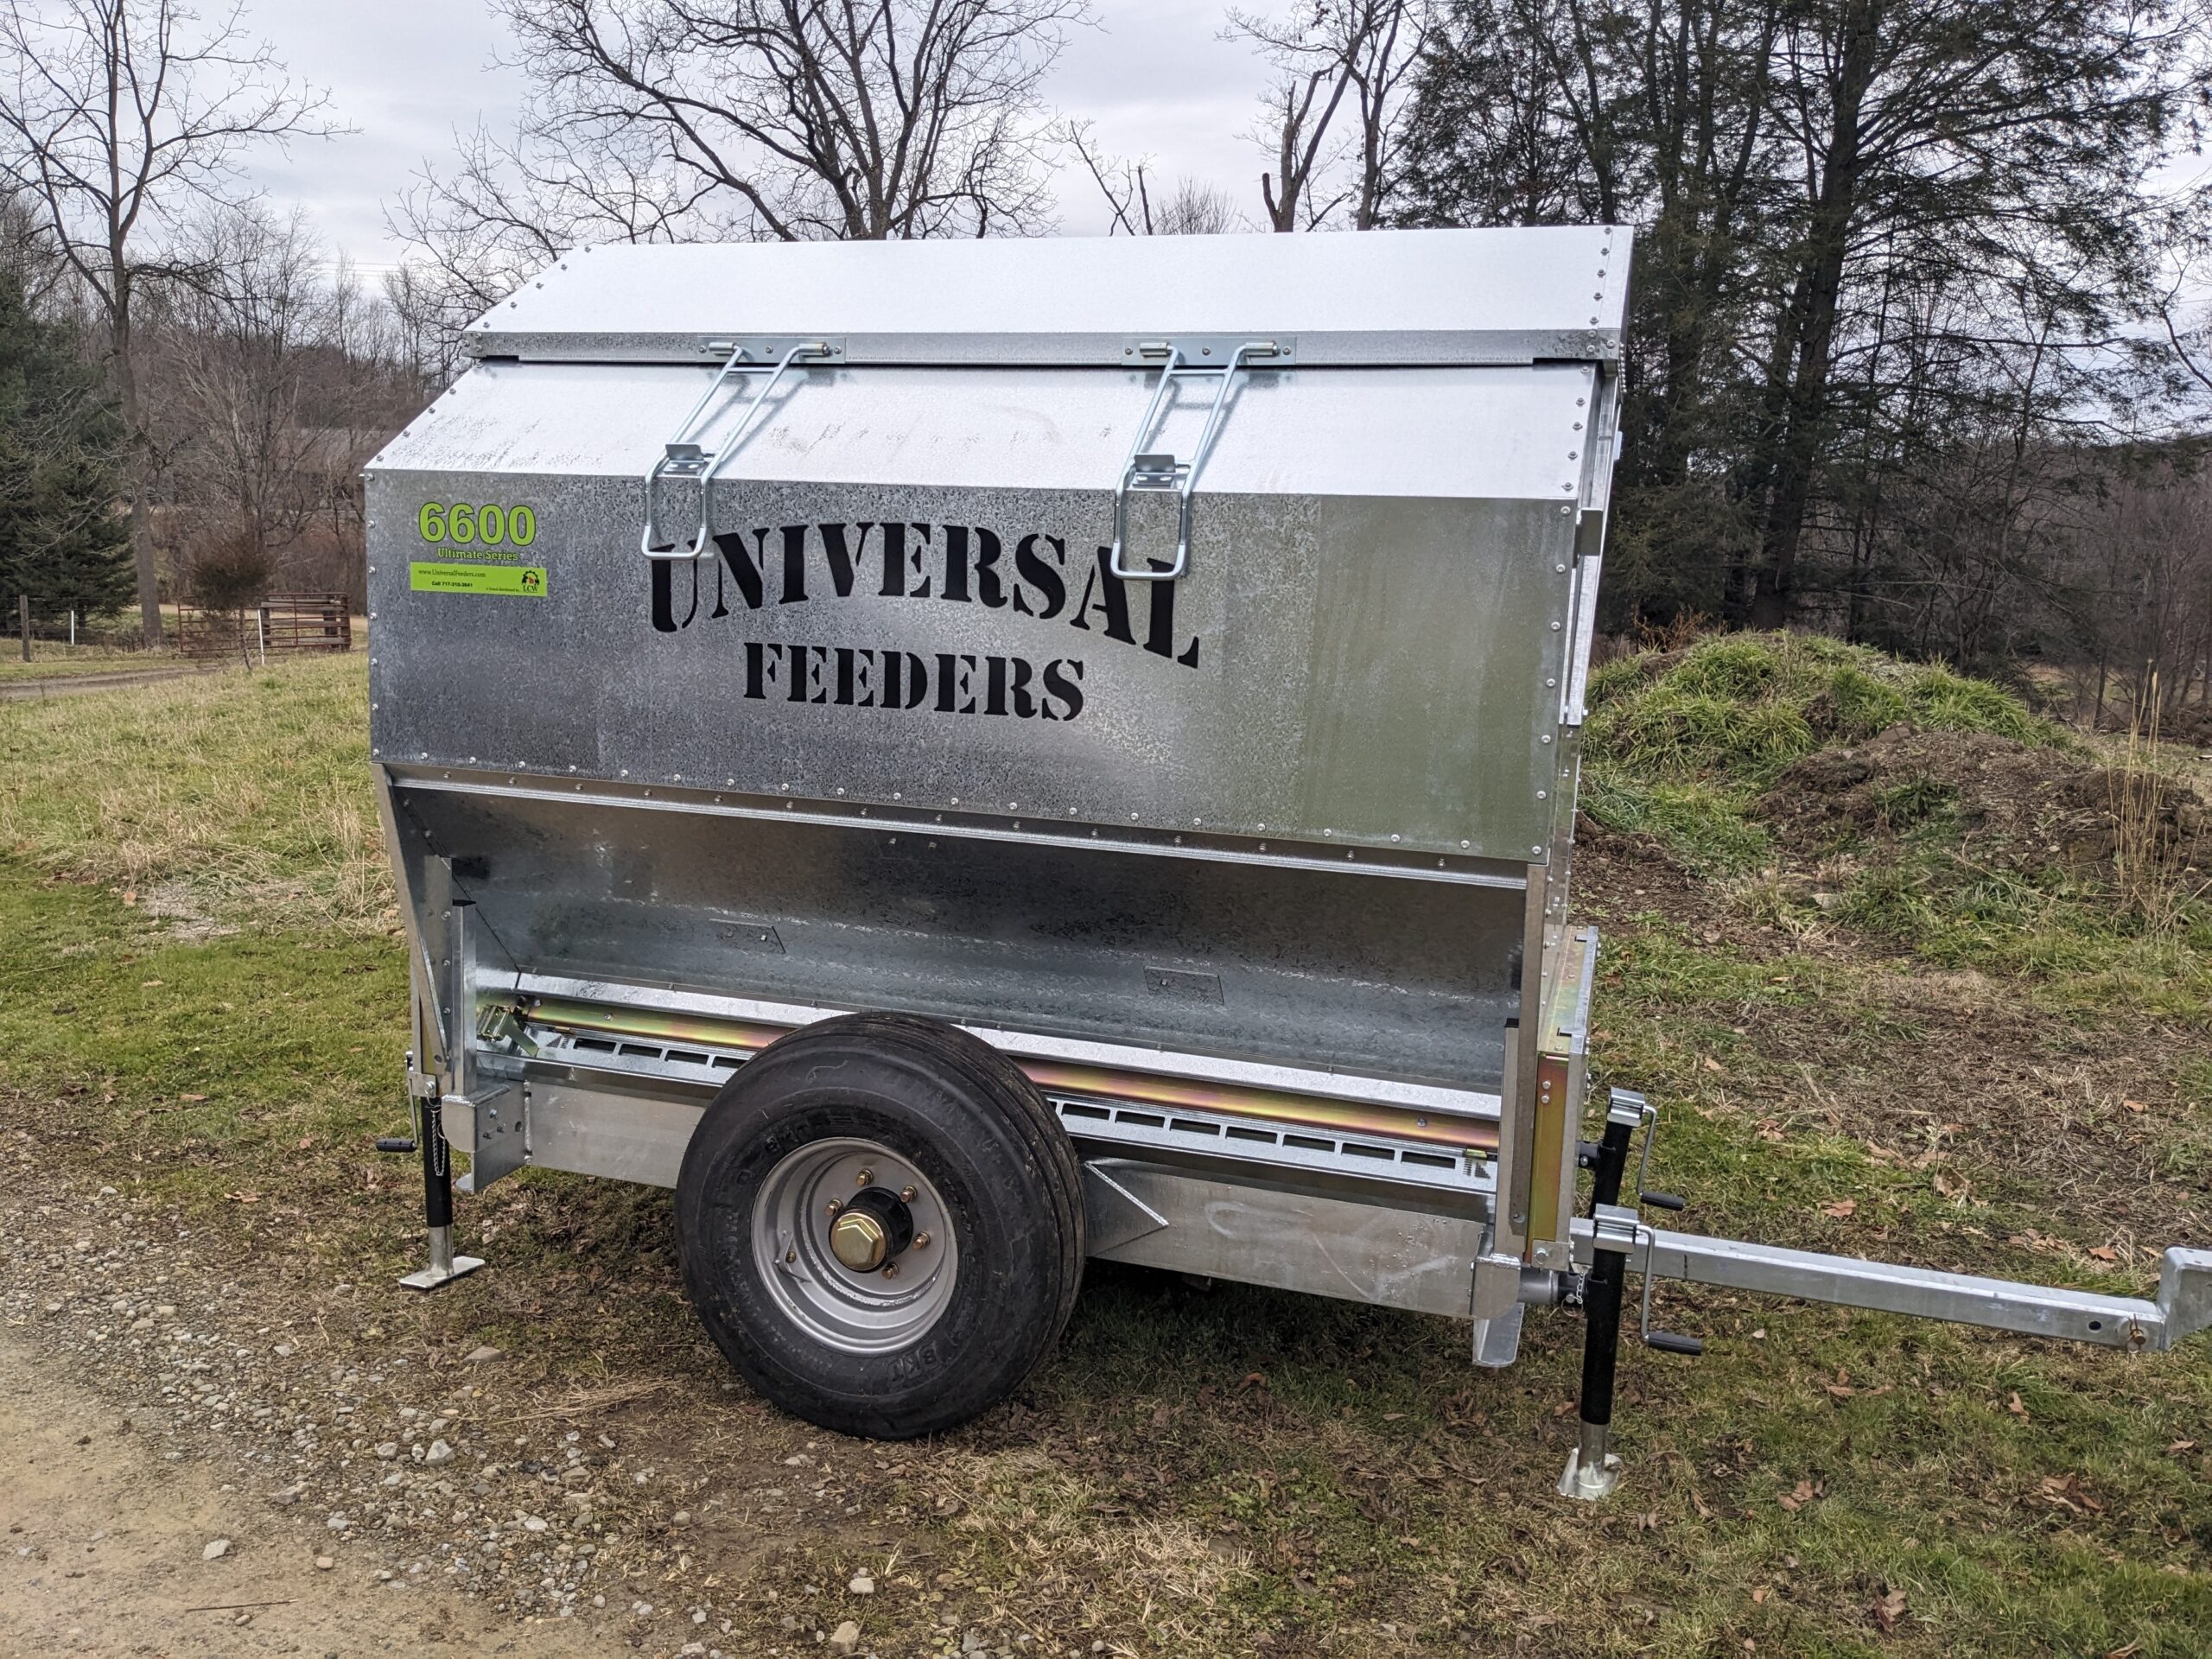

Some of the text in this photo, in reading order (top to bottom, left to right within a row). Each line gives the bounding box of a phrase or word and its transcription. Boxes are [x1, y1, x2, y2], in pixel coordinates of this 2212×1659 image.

[418, 501, 537, 547] 6600
[436, 547, 519, 561] Ultimate Series
[651, 522, 1199, 670] UNIVERSAL
[743, 642, 1084, 722] FEEDERS
